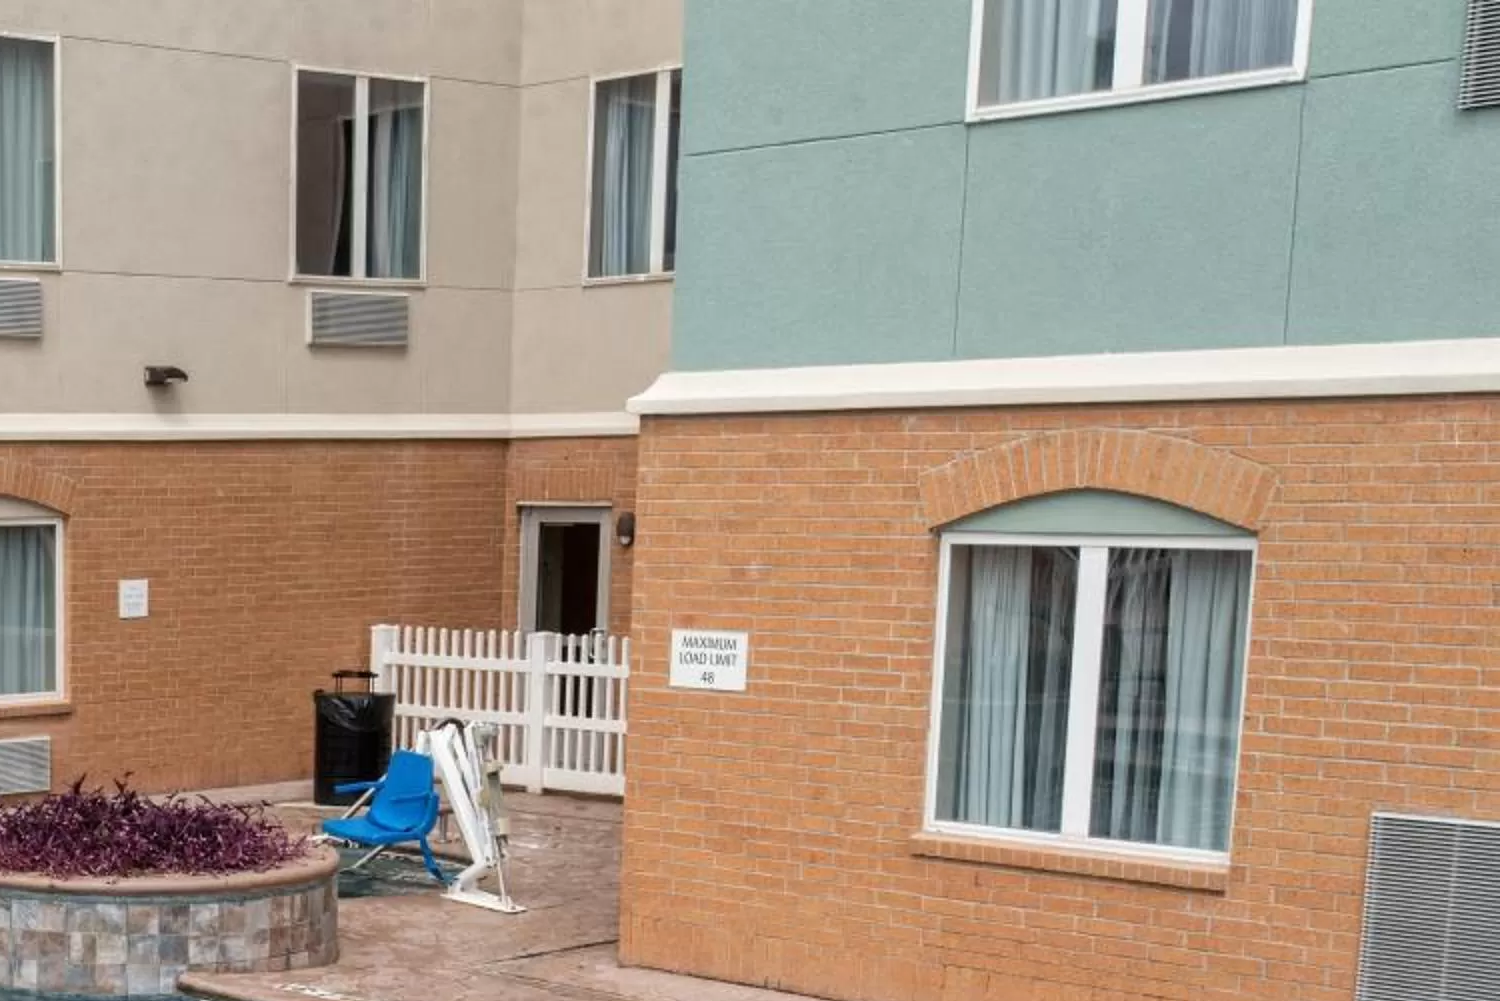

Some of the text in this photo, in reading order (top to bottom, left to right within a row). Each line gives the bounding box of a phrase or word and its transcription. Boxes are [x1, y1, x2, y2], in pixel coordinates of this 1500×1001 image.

[682, 635, 737, 650] MAXIMUM
[678, 651, 737, 667] LOAD LIMIT
